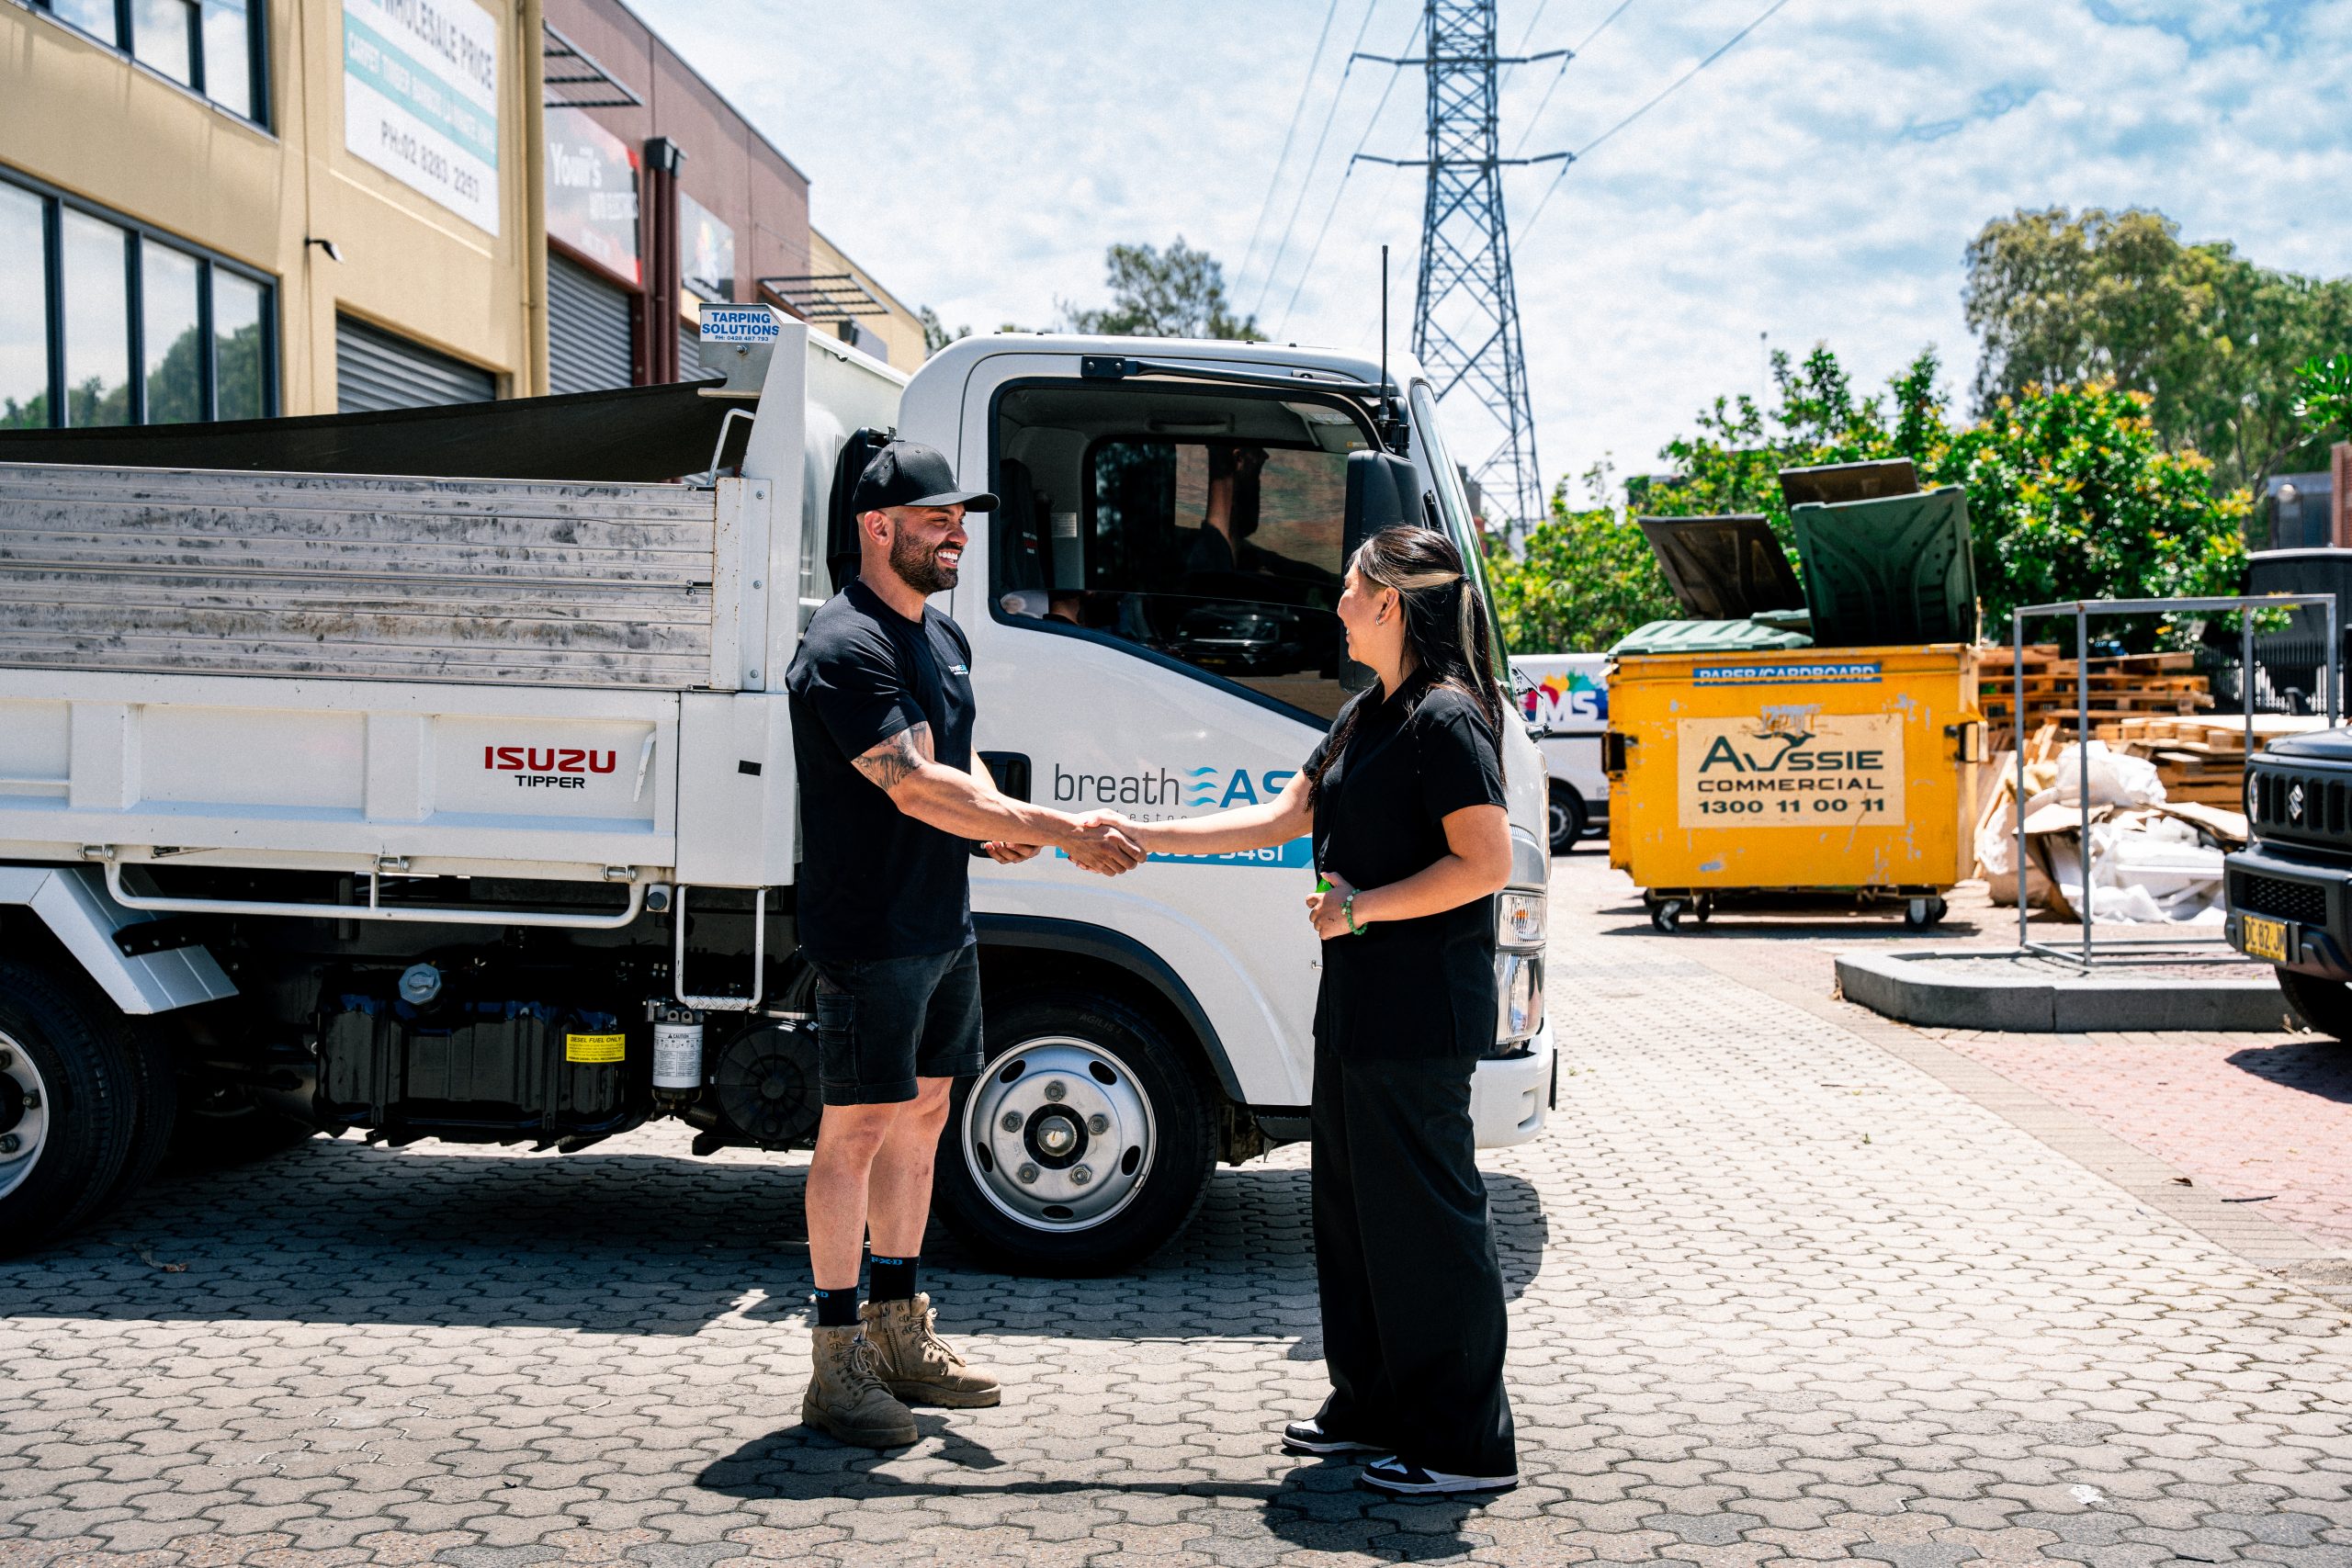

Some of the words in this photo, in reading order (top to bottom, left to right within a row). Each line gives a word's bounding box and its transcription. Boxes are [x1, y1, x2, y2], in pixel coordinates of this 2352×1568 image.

[711, 312, 771, 323] TARPING
[702, 324, 780, 335] SOLUTIONS
[485, 746, 616, 773] ISUZU
[514, 774, 585, 788] TIPPER
[1698, 777, 1883, 792] COMMERCIAL
[1699, 800, 1763, 814] 1300
[1777, 800, 1801, 813] 11
[1814, 799, 1848, 812] 00
[1861, 798, 1884, 812] 11
